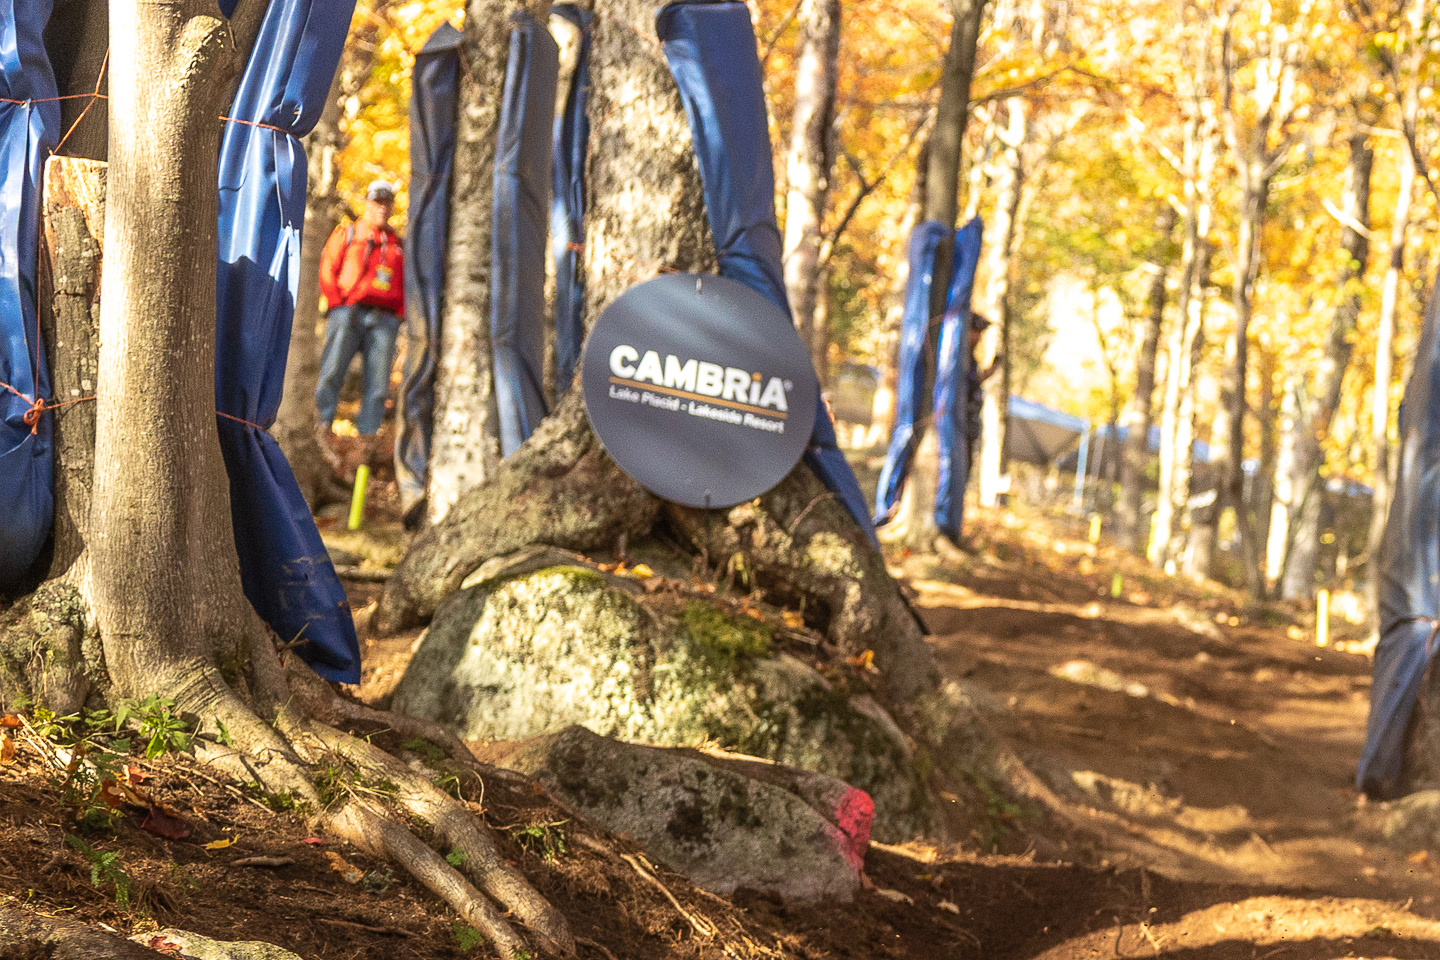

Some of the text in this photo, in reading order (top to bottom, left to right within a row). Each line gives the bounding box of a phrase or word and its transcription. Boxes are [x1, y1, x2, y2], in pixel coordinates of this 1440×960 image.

[609, 384, 641, 403] Lake
[641, 390, 681, 411] Placid
[688, 401, 743, 425] Lakeside
[743, 413, 785, 434] Resort
